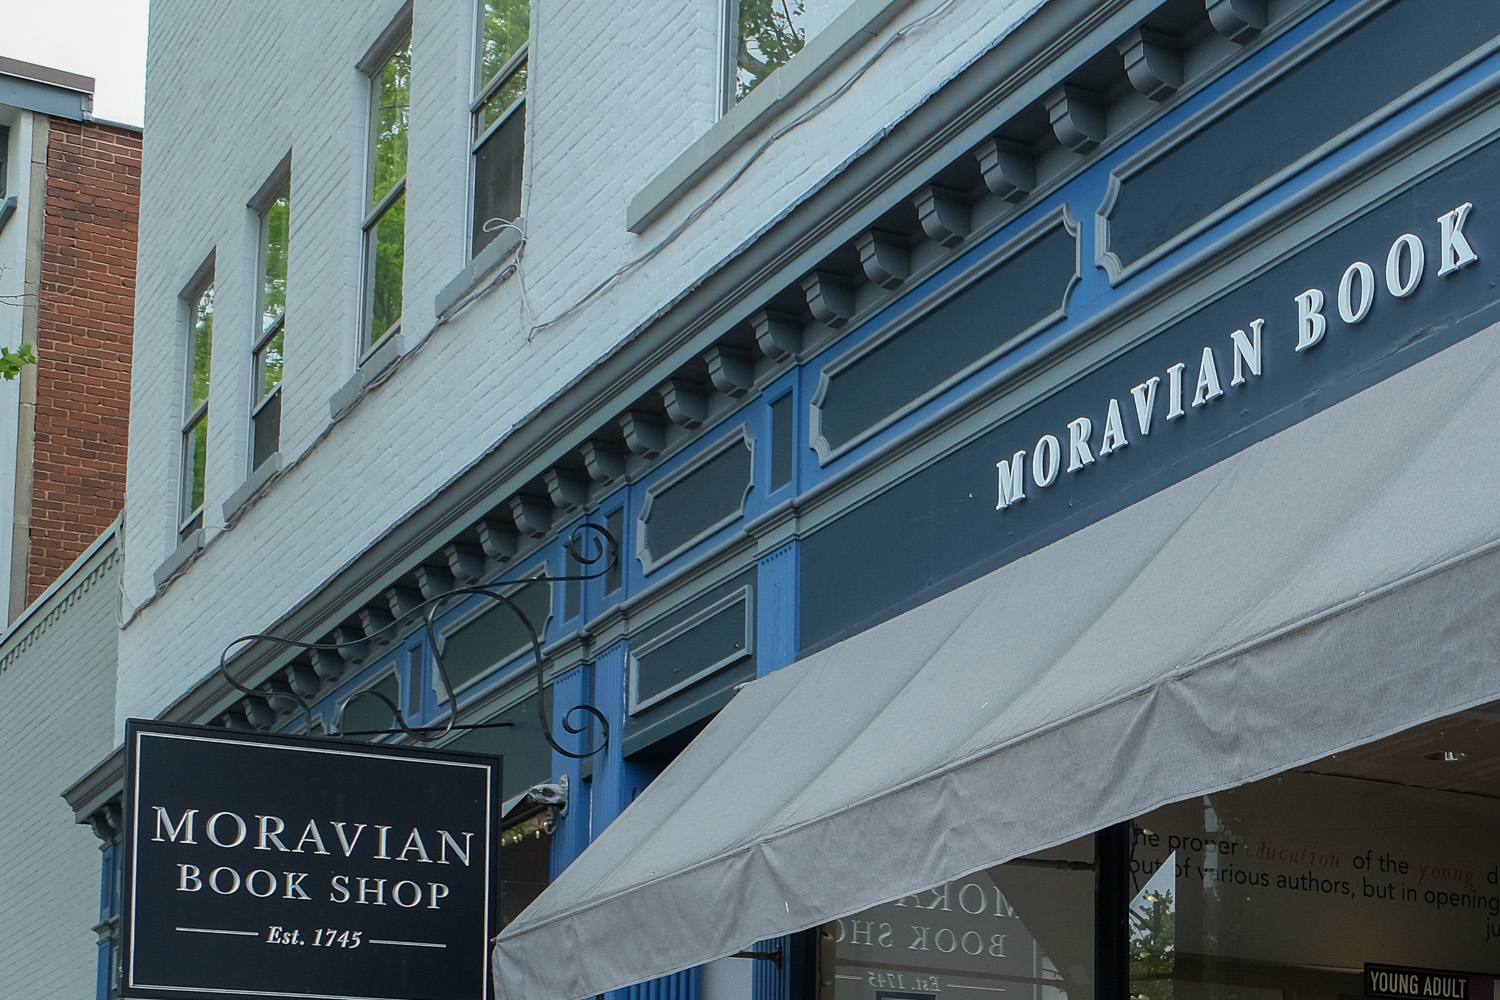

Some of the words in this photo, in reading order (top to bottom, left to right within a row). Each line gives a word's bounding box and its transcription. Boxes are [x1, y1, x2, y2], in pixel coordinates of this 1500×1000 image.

[995, 318, 1266, 510] MORAVIAN
[1295, 202, 1479, 351] BOOK
[151, 805, 475, 867] MORAVIAN
[1168, 834, 1239, 858] proper
[1244, 841, 1342, 869] education
[1353, 850, 1373, 870] of
[1378, 852, 1409, 874] the
[1416, 864, 1476, 891] young
[176, 863, 312, 901] BOOK
[330, 874, 450, 909] SHOP
[1198, 863, 1270, 887] various
[1276, 871, 1356, 898] authors,
[1363, 877, 1395, 900] but
[1402, 882, 1417, 902] in
[1424, 888, 1500, 917] opening
[265, 926, 305, 946] Est.
[311, 928, 363, 949] 1745
[1370, 970, 1420, 996] YOUNG
[1423, 976, 1467, 1000] ADULT
